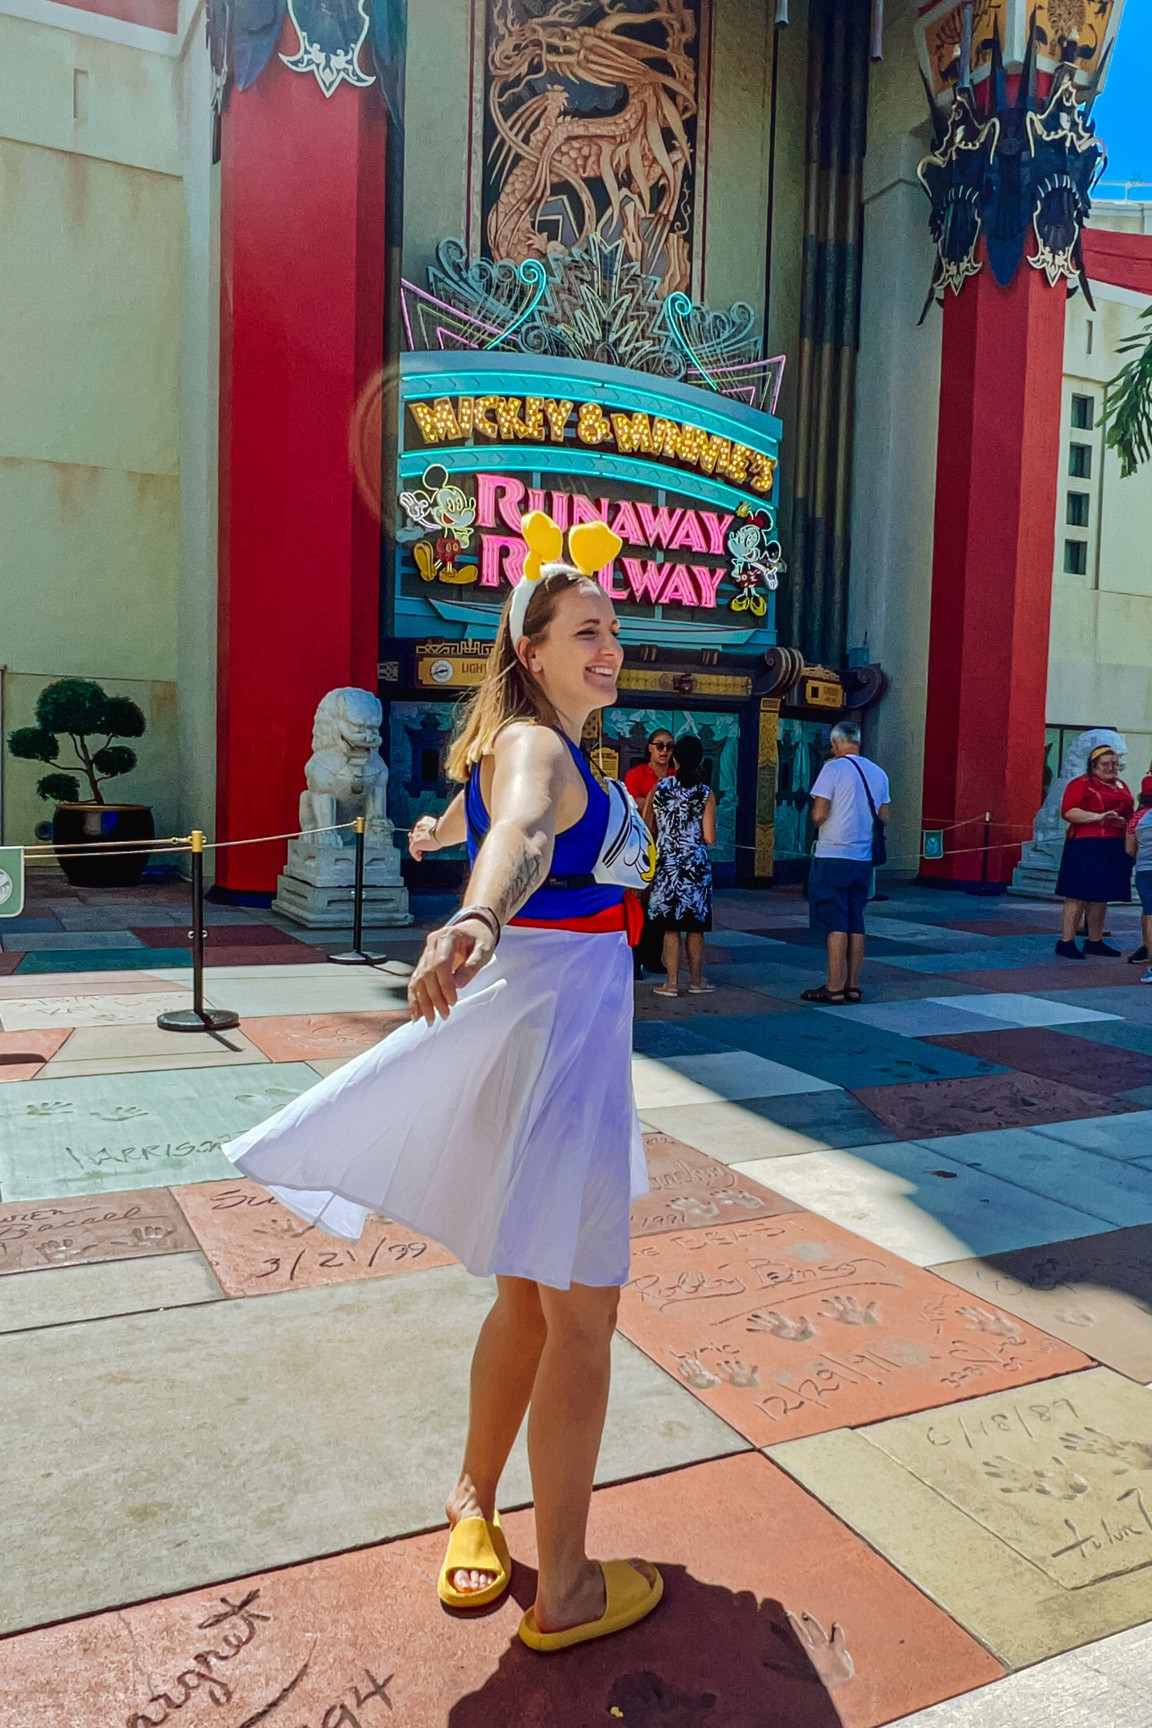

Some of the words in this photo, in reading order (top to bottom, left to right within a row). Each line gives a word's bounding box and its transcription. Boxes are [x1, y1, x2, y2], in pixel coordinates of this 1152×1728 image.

[409, 394, 573, 443] MICKEY
[576, 402, 613, 445] &
[610, 412, 779, 493] MINNIE'S
[474, 473, 735, 557] RUNAWAY
[479, 533, 727, 609] RLWAY
